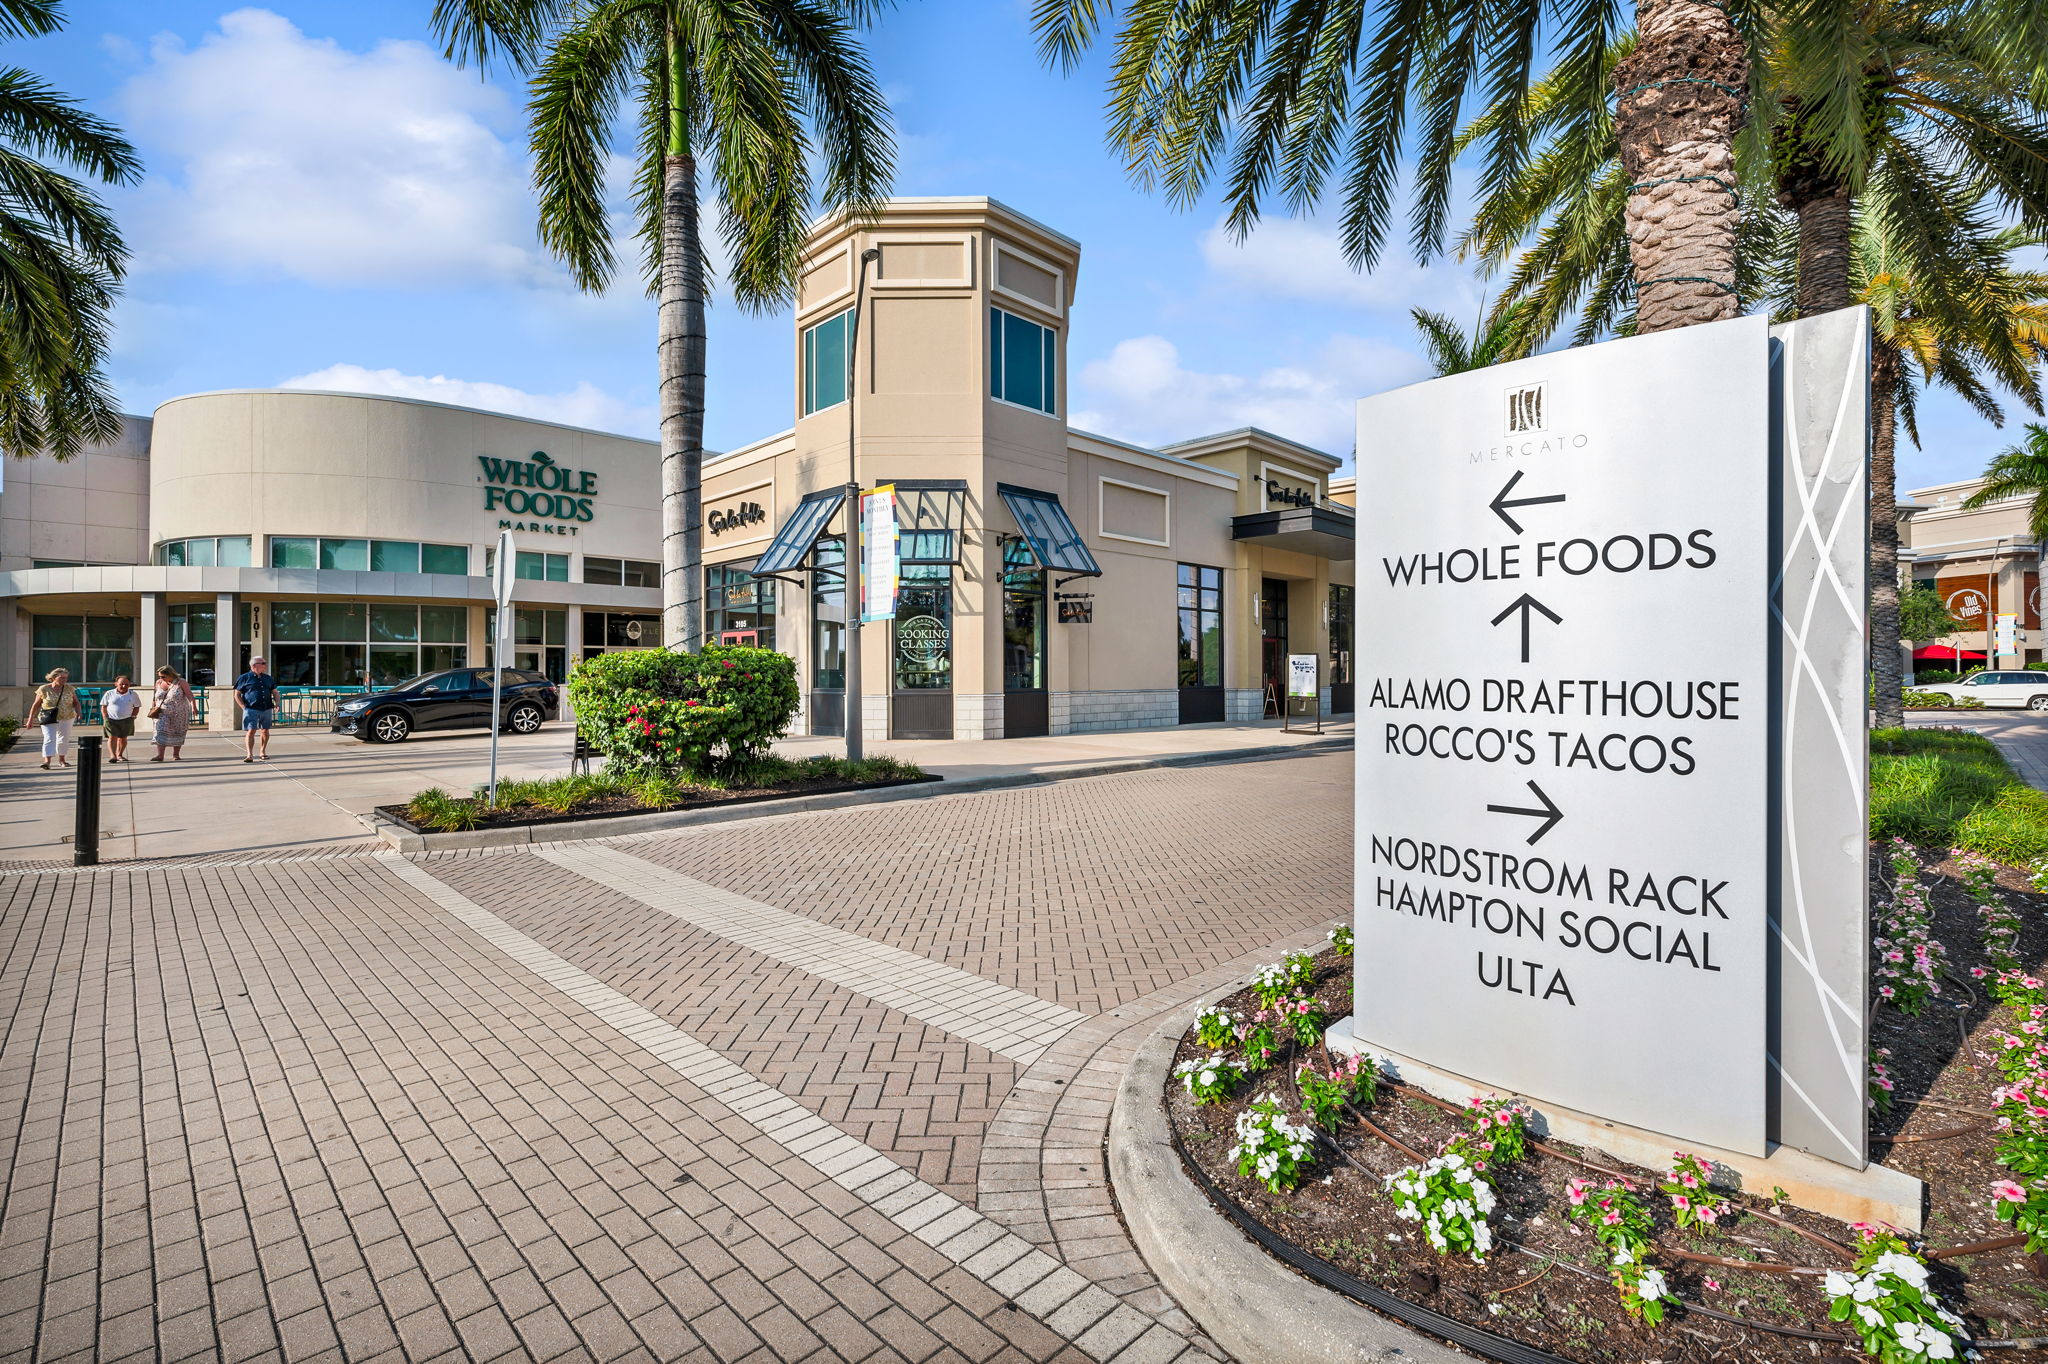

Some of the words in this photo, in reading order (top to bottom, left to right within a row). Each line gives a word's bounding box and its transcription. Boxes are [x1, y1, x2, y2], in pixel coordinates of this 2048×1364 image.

[1470, 434, 1588, 464] MERCATO
[478, 455, 598, 496] WHOLE
[483, 485, 595, 523] FOODS
[498, 519, 579, 537] MARKET
[1383, 544, 1520, 587] WHOLE
[1538, 529, 1717, 577] FOODS
[1960, 604, 1983, 618] Vines
[1964, 594, 1978, 607] Old
[253, 606, 261, 639] 9101
[898, 629, 950, 639] COOKING
[900, 639, 947, 649] CLASSES
[1369, 677, 1471, 712] ALAMO
[1483, 678, 1740, 721] DRAFTHOUSE
[1385, 722, 1536, 766] ROCCO'S
[1548, 731, 1697, 776] TACOS
[1372, 833, 1594, 901] NORDSTROM
[1608, 867, 1730, 920] RACK
[1377, 876, 1544, 942] HAMPTON
[1558, 910, 1721, 972] SOCIAL
[1478, 951, 1576, 1007] ULTA
